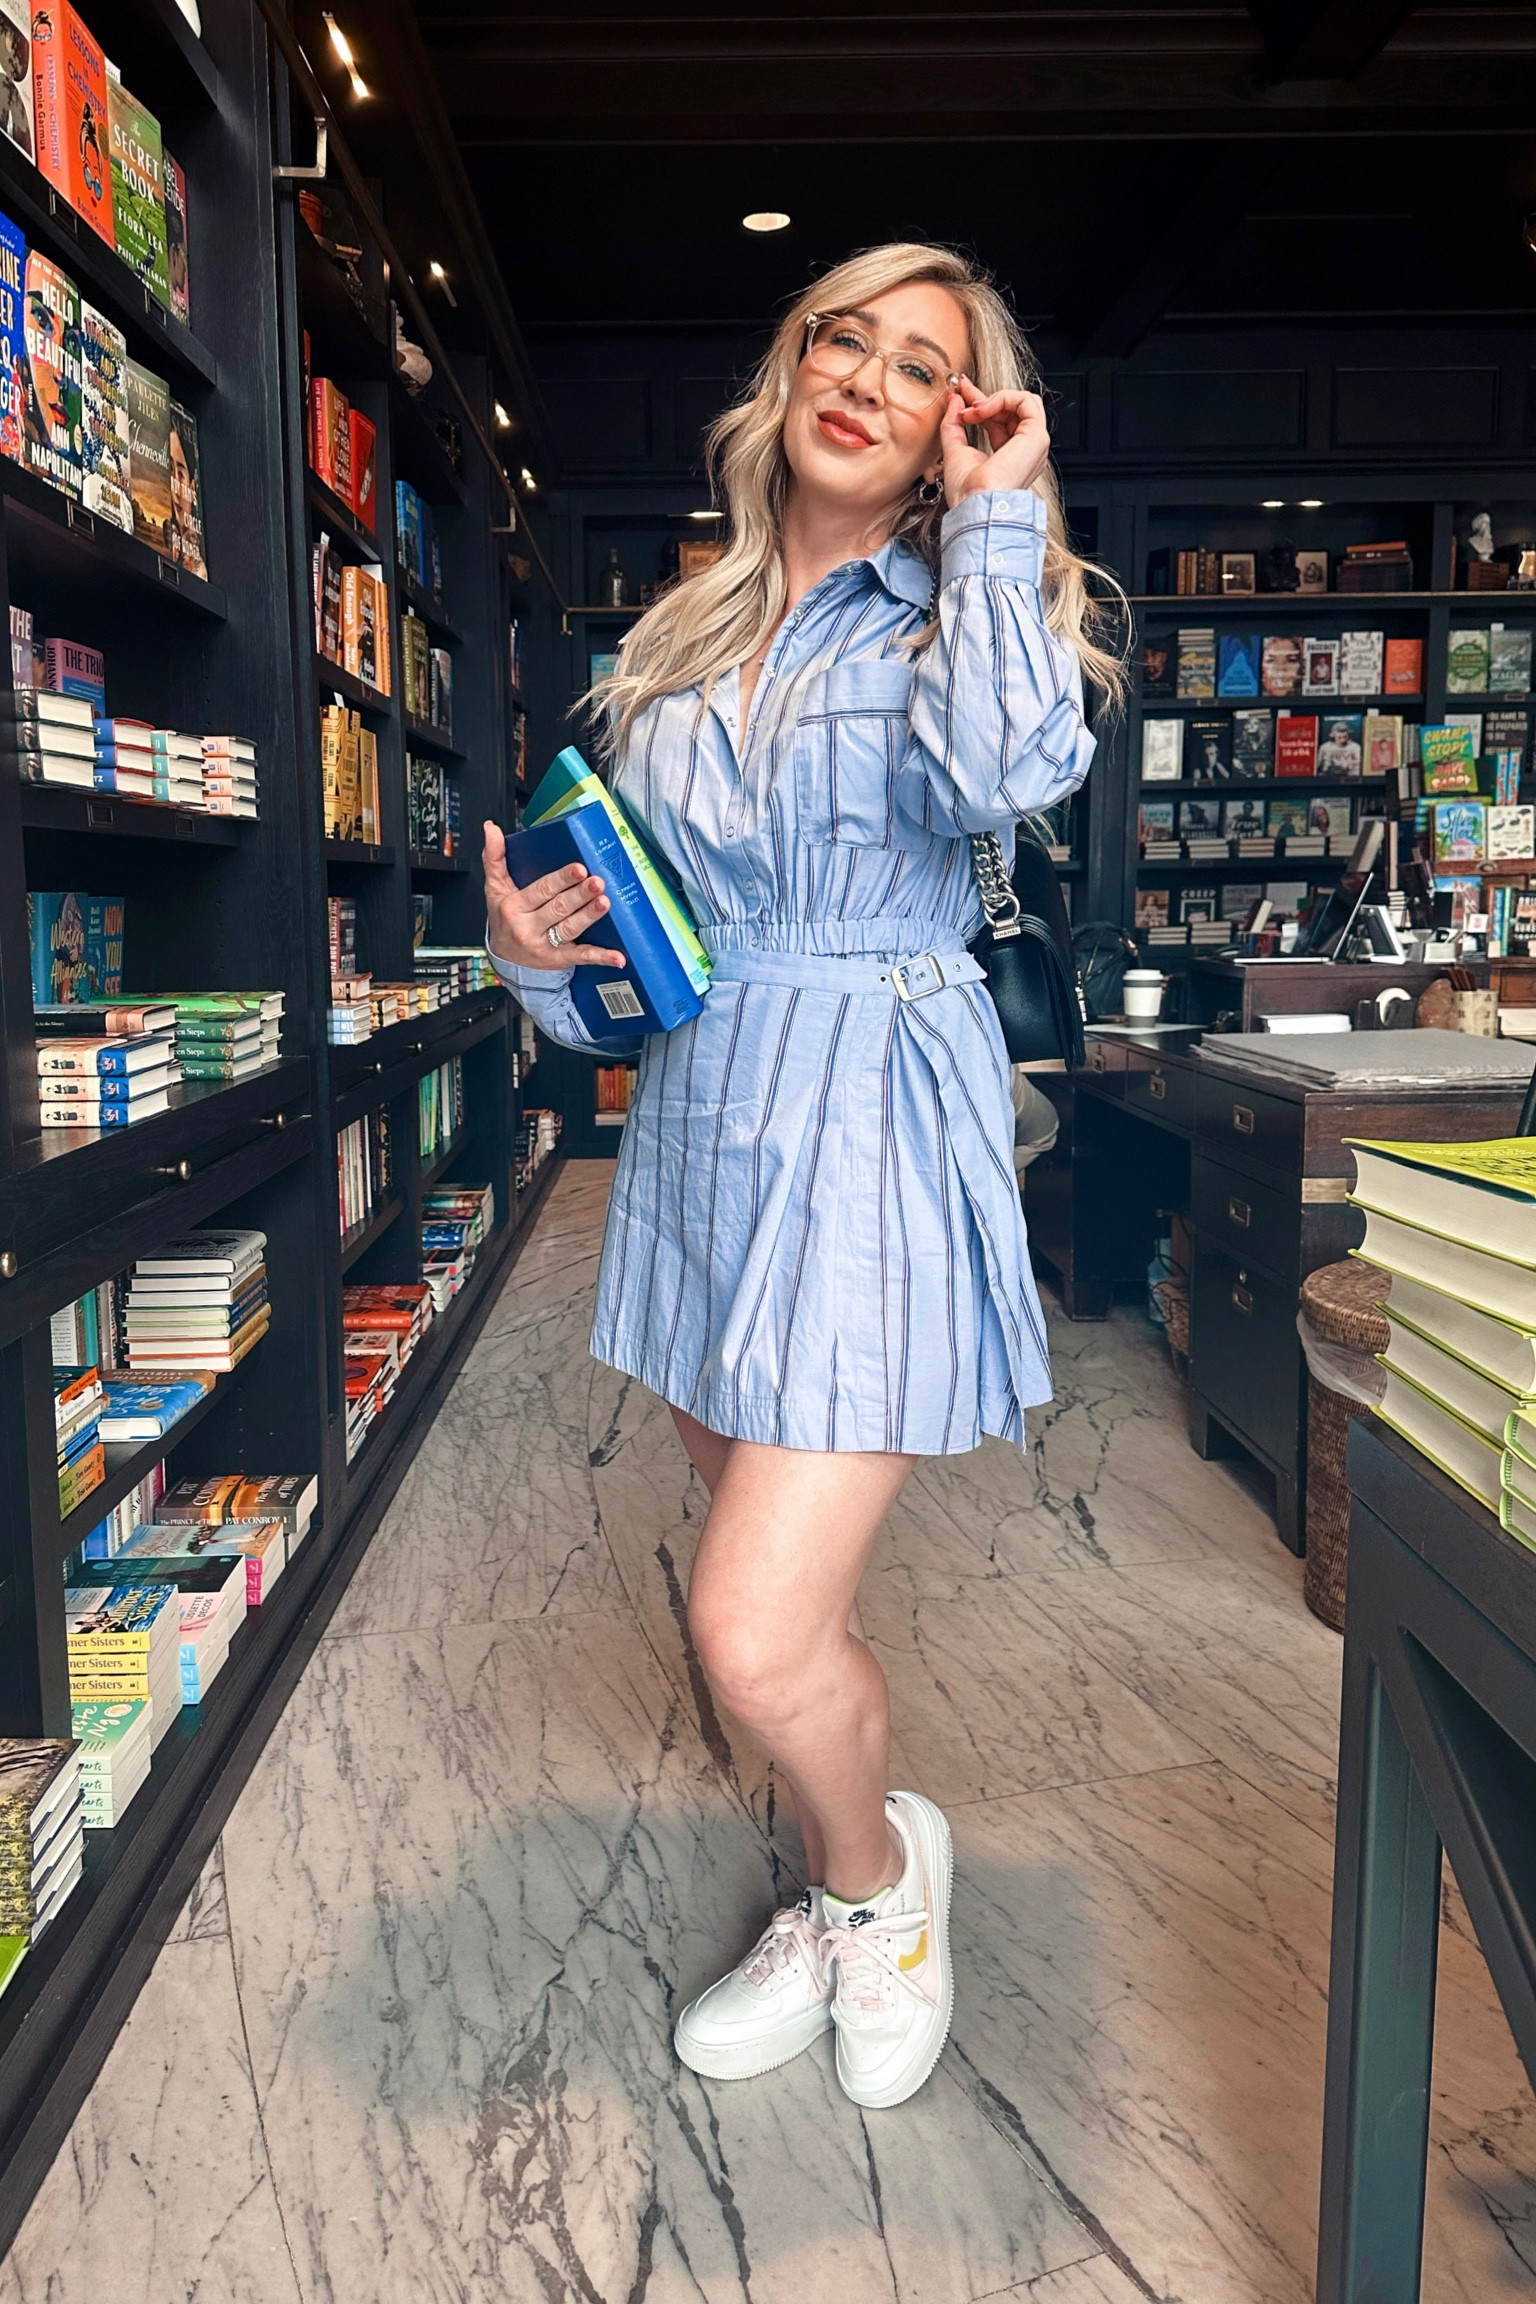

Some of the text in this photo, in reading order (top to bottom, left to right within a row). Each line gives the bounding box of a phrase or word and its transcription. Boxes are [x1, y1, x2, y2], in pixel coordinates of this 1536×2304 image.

[69, 23, 100, 78] LESSONS
[46, 54, 57, 100] LESSONS
[67, 61, 107, 119] CHEMISTRY
[36, 74, 46, 151] Bonnie Garmus
[49, 113, 61, 171] CHEMISTRY
[114, 123, 159, 182] SECRET
[121, 158, 156, 207] BOOK
[118, 207, 145, 240] FLORA
[147, 231, 164, 255] LEA
[42, 277, 74, 327] HELLO
[27, 327, 82, 389] BEAUTIFUL
[127, 375, 167, 412] PAULETTE
[138, 400, 160, 422] JILES
[51, 421, 70, 452] ANN
[128, 418, 170, 470] Chenneville
[344, 572, 354, 625] Old Enough
[9, 605, 31, 641] THE
[63, 646, 83, 671] THE
[1424, 726, 1470, 744] SWAMP
[1427, 741, 1469, 757] STORY
[1434, 761, 1466, 775] DAVE
[1431, 774, 1471, 791] BARRY
[1441, 806, 1477, 829] Silver
[1180, 889, 1217, 899] CREEP
[104, 905, 124, 937] NOW
[105, 941, 122, 972] YOU
[104, 975, 121, 995] SEE
[186, 1028, 206, 1037] Steps
[186, 1047, 205, 1057] Steps
[186, 1066, 205, 1076] Steps
[225, 1516, 281, 1525] PAT CONROY
[101, 1588, 144, 1628] Summer
[128, 1591, 165, 1622] Sisters
[184, 1595, 205, 1621] LISSETTE
[197, 1598, 214, 1618] DECOS
[68, 1636, 126, 1647] mer Sisters
[69, 1658, 123, 1668] mer Sisters
[70, 1680, 123, 1690] mer Sisters
[73, 1705, 98, 1733] este
[87, 1717, 121, 1738] Ng
[79, 1779, 104, 1790] earts
[81, 1797, 104, 1808] earts
[84, 1816, 105, 1826] arts
